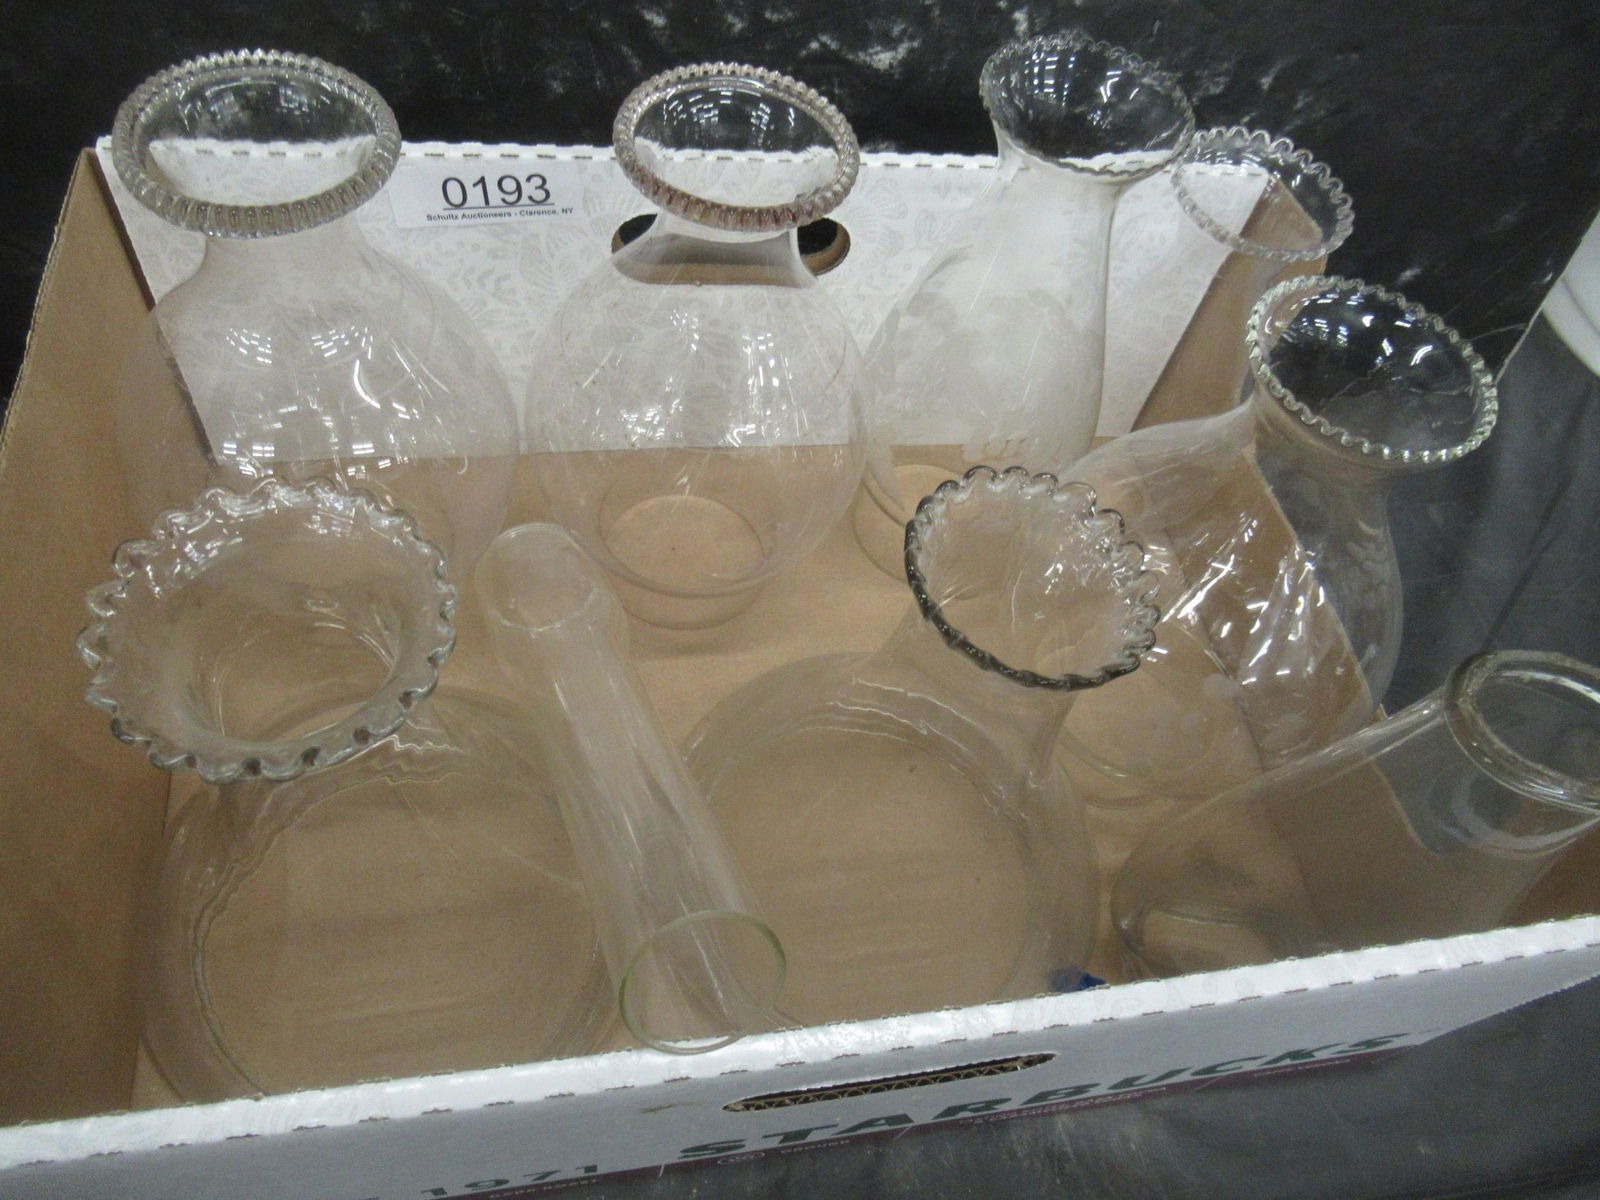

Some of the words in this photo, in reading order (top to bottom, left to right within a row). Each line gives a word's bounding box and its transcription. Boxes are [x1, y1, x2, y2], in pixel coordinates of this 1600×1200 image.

[441, 173, 552, 209] 0193
[426, 213, 459, 221] Schultz
[461, 210, 512, 220] Auctioneers
[519, 208, 560, 217] Clarence,
[677, 1033, 1411, 1160] STARBUCKS
[420, 1164, 598, 1196] 1971
